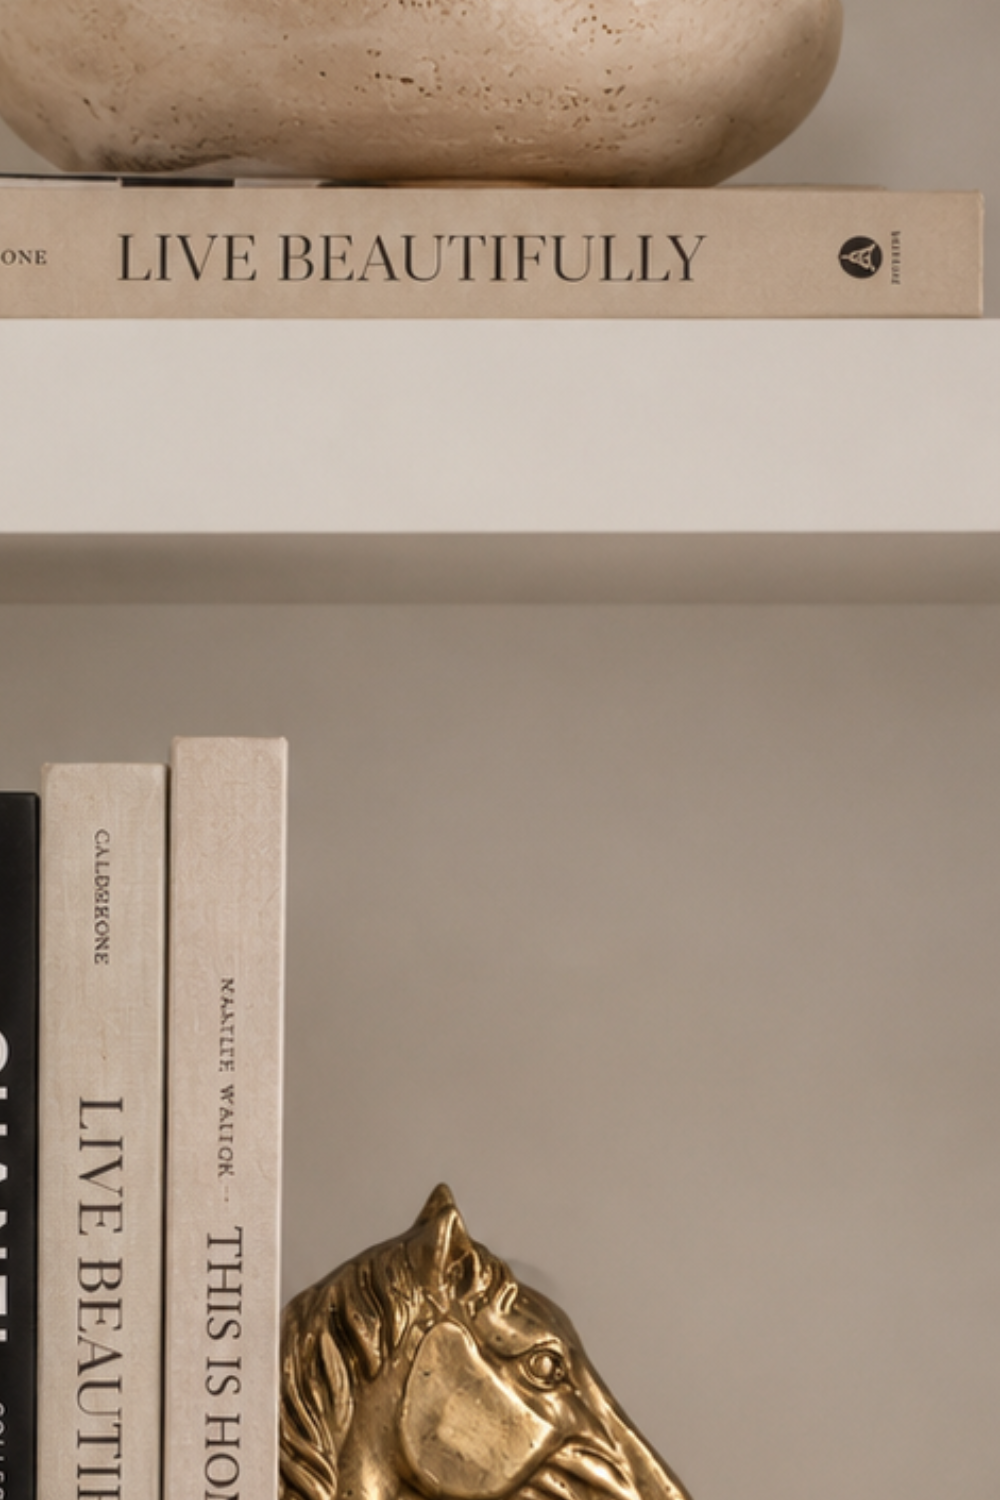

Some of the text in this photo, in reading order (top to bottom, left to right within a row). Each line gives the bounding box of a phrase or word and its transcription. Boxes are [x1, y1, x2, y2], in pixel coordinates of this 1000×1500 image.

[117, 233, 707, 282] LIVE BEAUTIFULLY
[78, 1096, 124, 1237] LIVE
[206, 1226, 243, 1341] THIS
[205, 1356, 242, 1397] IS
